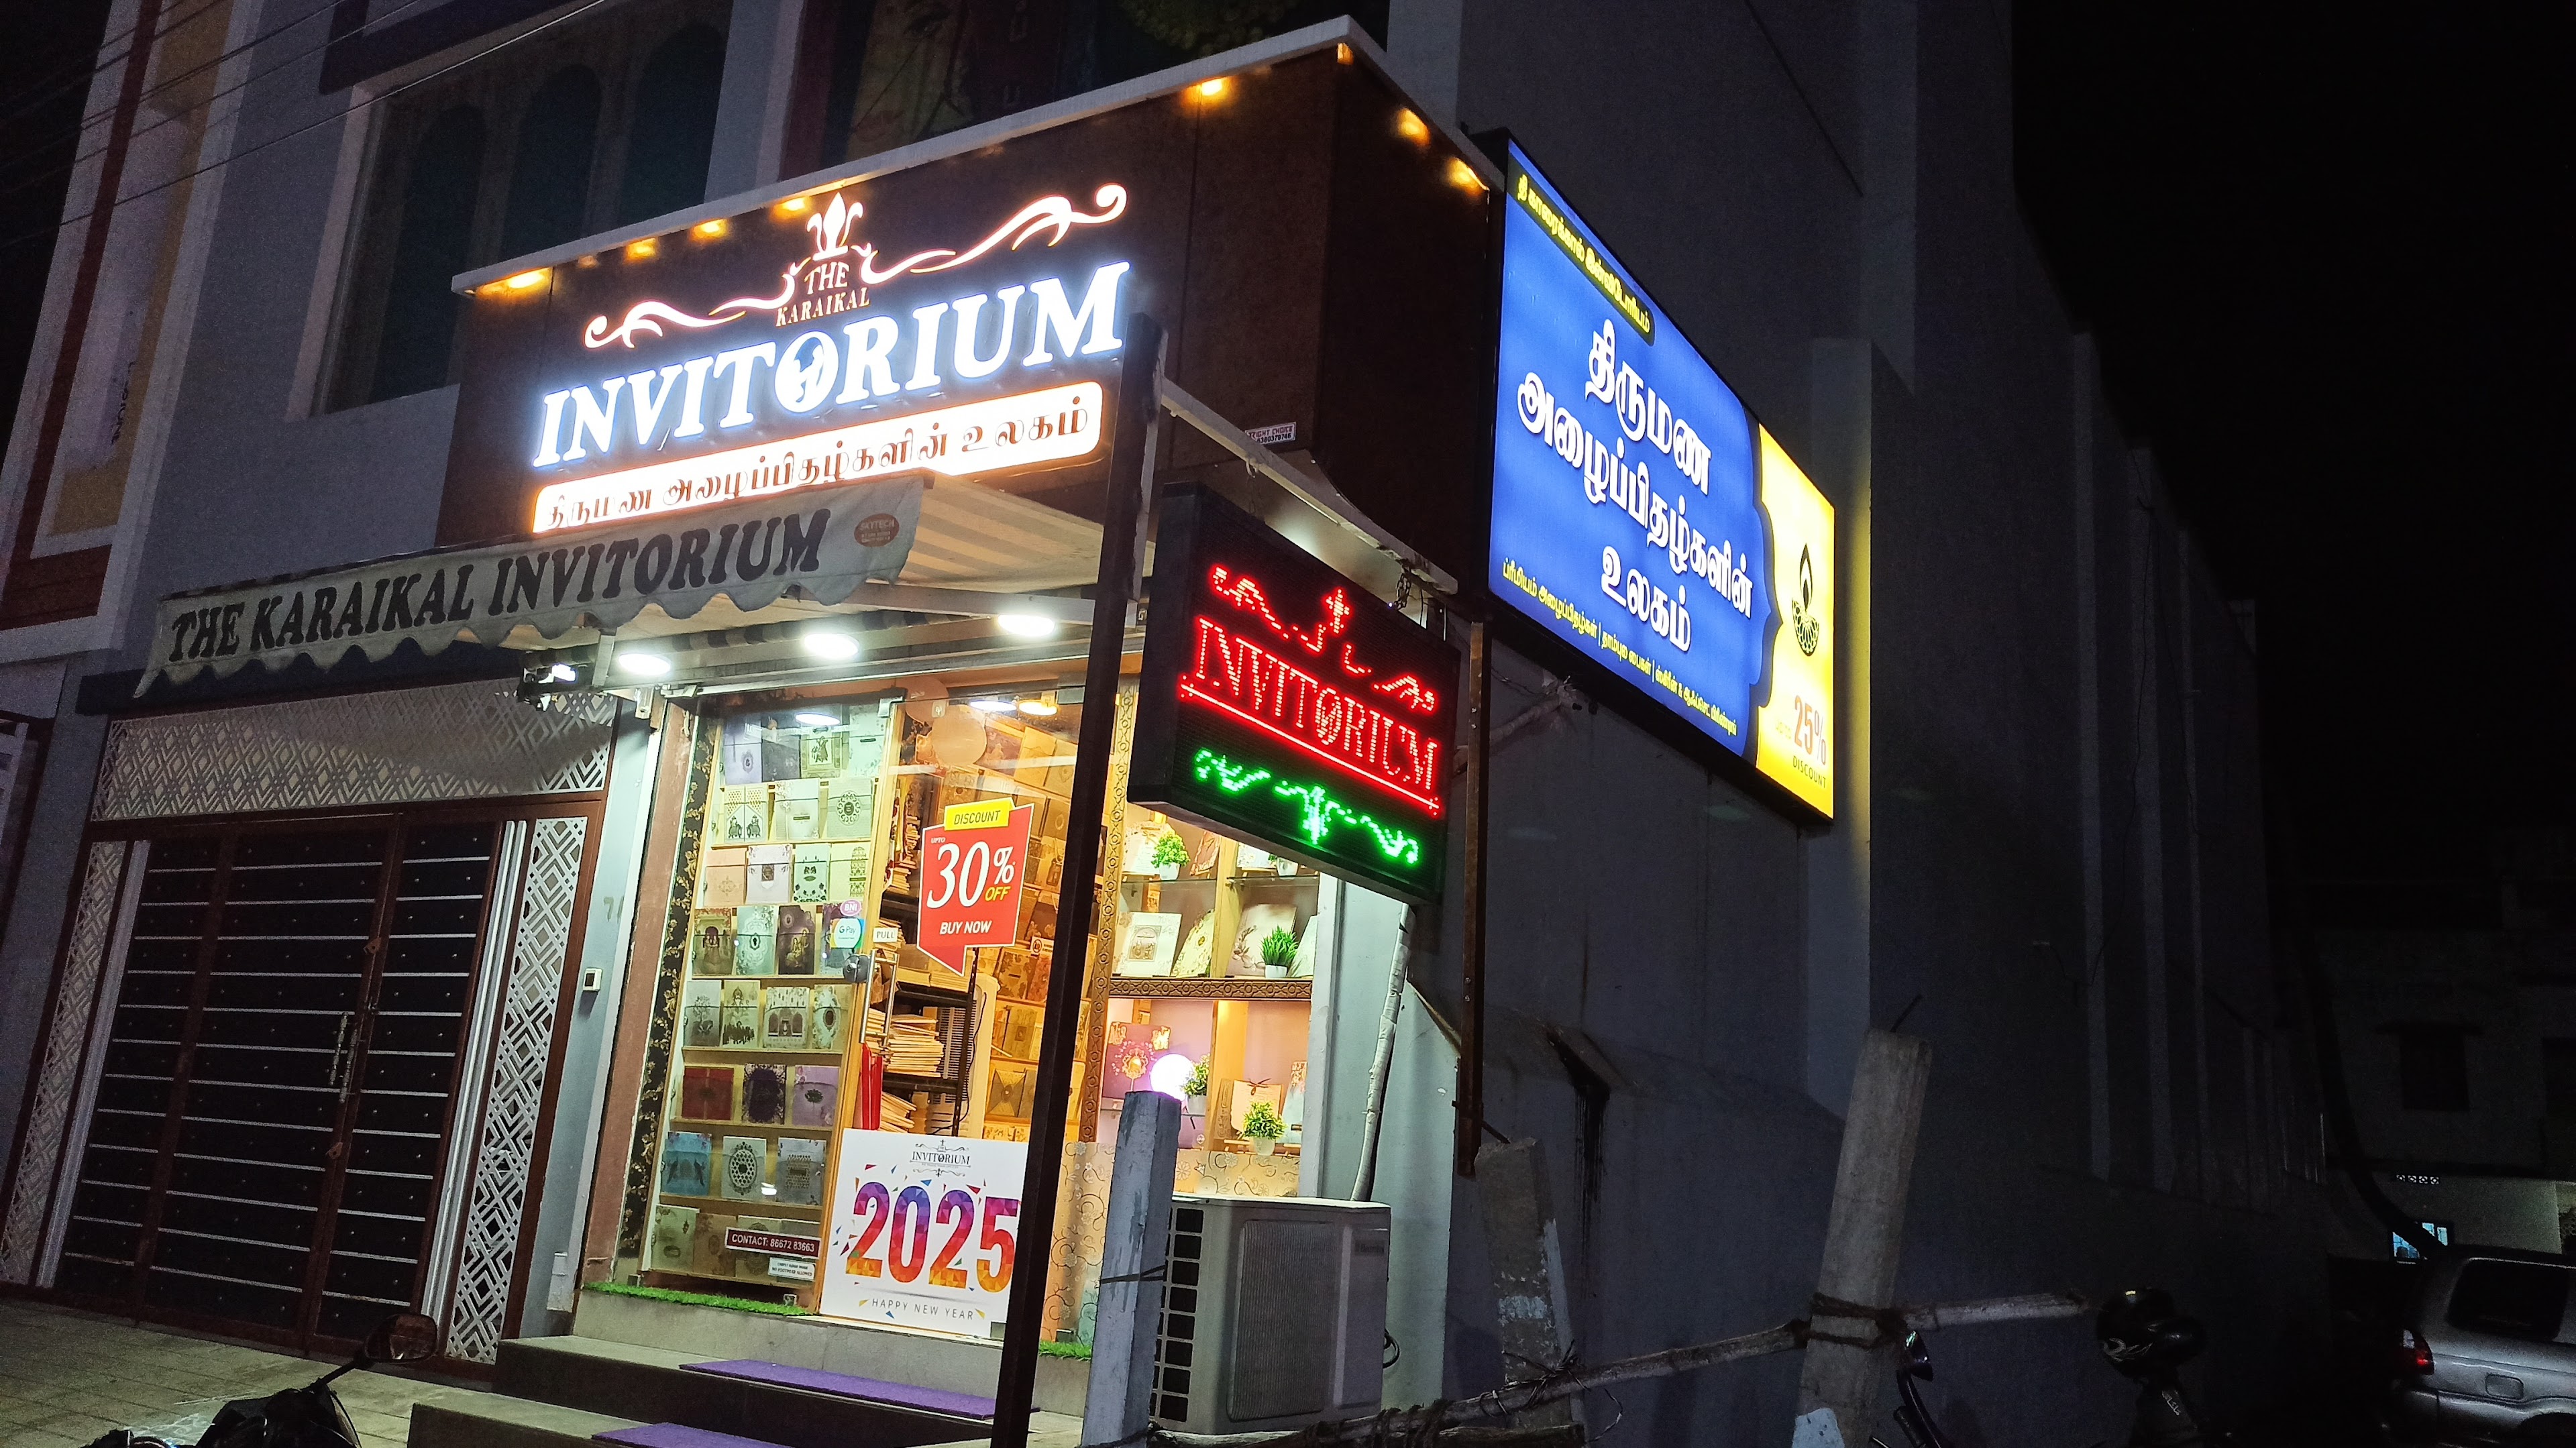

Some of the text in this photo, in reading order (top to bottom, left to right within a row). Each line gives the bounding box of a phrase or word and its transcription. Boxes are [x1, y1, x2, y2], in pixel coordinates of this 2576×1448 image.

[804, 261, 850, 295] THE
[775, 287, 871, 327] KARAIKAL
[532, 260, 1131, 469] INVITORIUM
[1585, 319, 1712, 495] திருமண
[663, 423, 947, 502] அழைப்பிதழ்களின்
[962, 395, 1088, 452] உலகம்
[1517, 372, 1753, 618] அழைப்பிதழ்களின்
[168, 508, 832, 662] THE KARAIKAL INVITORIUM
[1601, 545, 1692, 651] உலகம்
[1538, 586, 1598, 638] அழைப்பிதழ்கள்
[1794, 695, 1827, 765] 25%
[1792, 755, 1827, 789] DISCOUNT
[953, 810, 1001, 825] DISCOUNT
[926, 840, 1016, 909] 30%
[844, 903, 858, 911] BNI
[985, 886, 1012, 901] OFF
[846, 926, 857, 934] Pay
[876, 931, 895, 939] PULL
[939, 920, 993, 935] BUY NOW
[912, 1151, 970, 1165] INVITORIUM
[732, 1233, 769, 1246] CONTACT:
[845, 1182, 1020, 1293] 2025
[872, 1298, 974, 1320] HAPPY NEW YEAR
